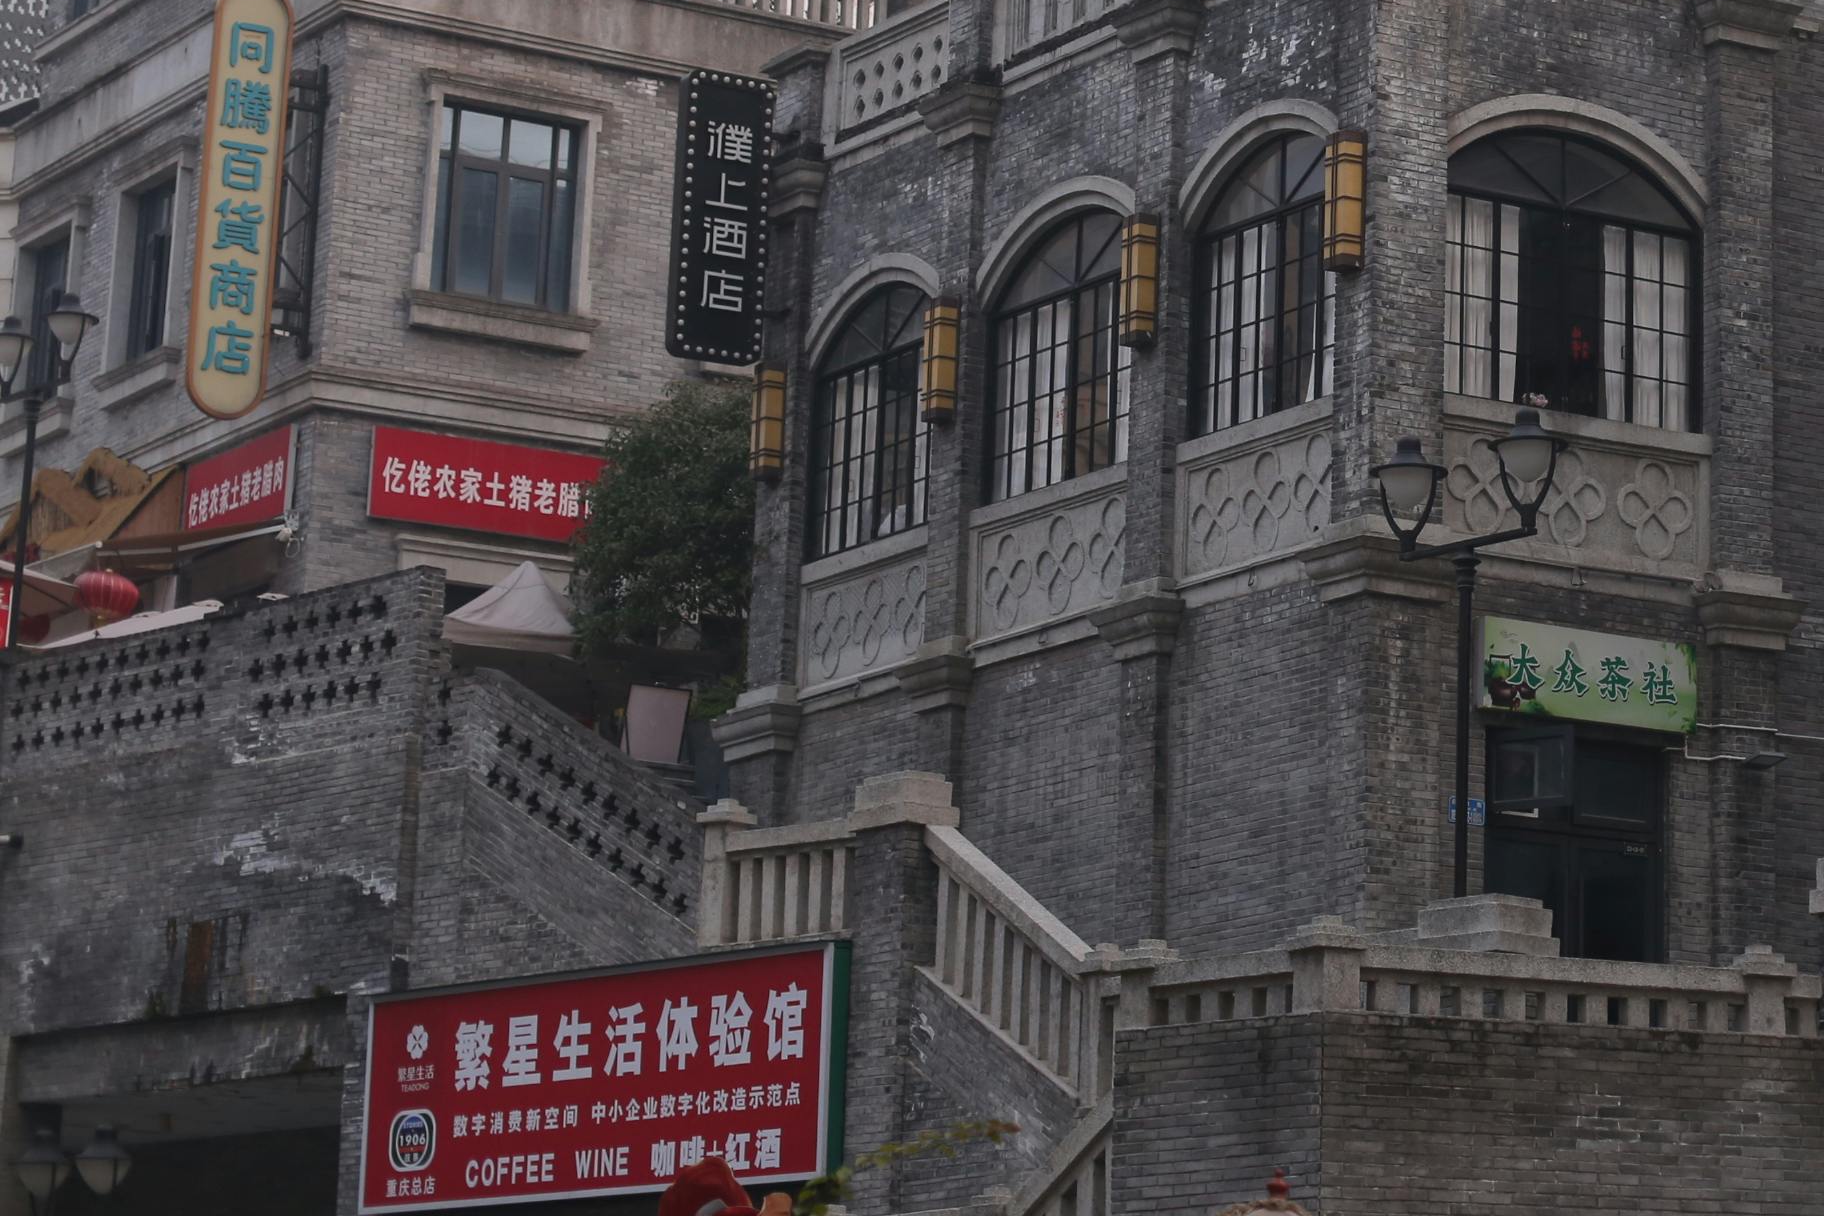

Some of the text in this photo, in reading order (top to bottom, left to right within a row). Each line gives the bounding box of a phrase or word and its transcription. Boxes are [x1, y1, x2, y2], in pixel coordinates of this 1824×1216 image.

[700, 120, 753, 313] 濮上酒店
[188, 455, 284, 529] 仡佬农家土猪老腊肉
[1505, 642, 1678, 706] 大众茶社
[454, 981, 808, 1093] 繁星生活体验馆
[398, 1065, 435, 1082] 繁星生活
[453, 1081, 801, 1138] 数字消费新空间 中小企业数字化改造示范点
[399, 1133, 426, 1147] 1906
[465, 1152, 555, 1189] COFFEE
[575, 1146, 629, 1180] WINE
[386, 1176, 435, 1198] 重庆总店
